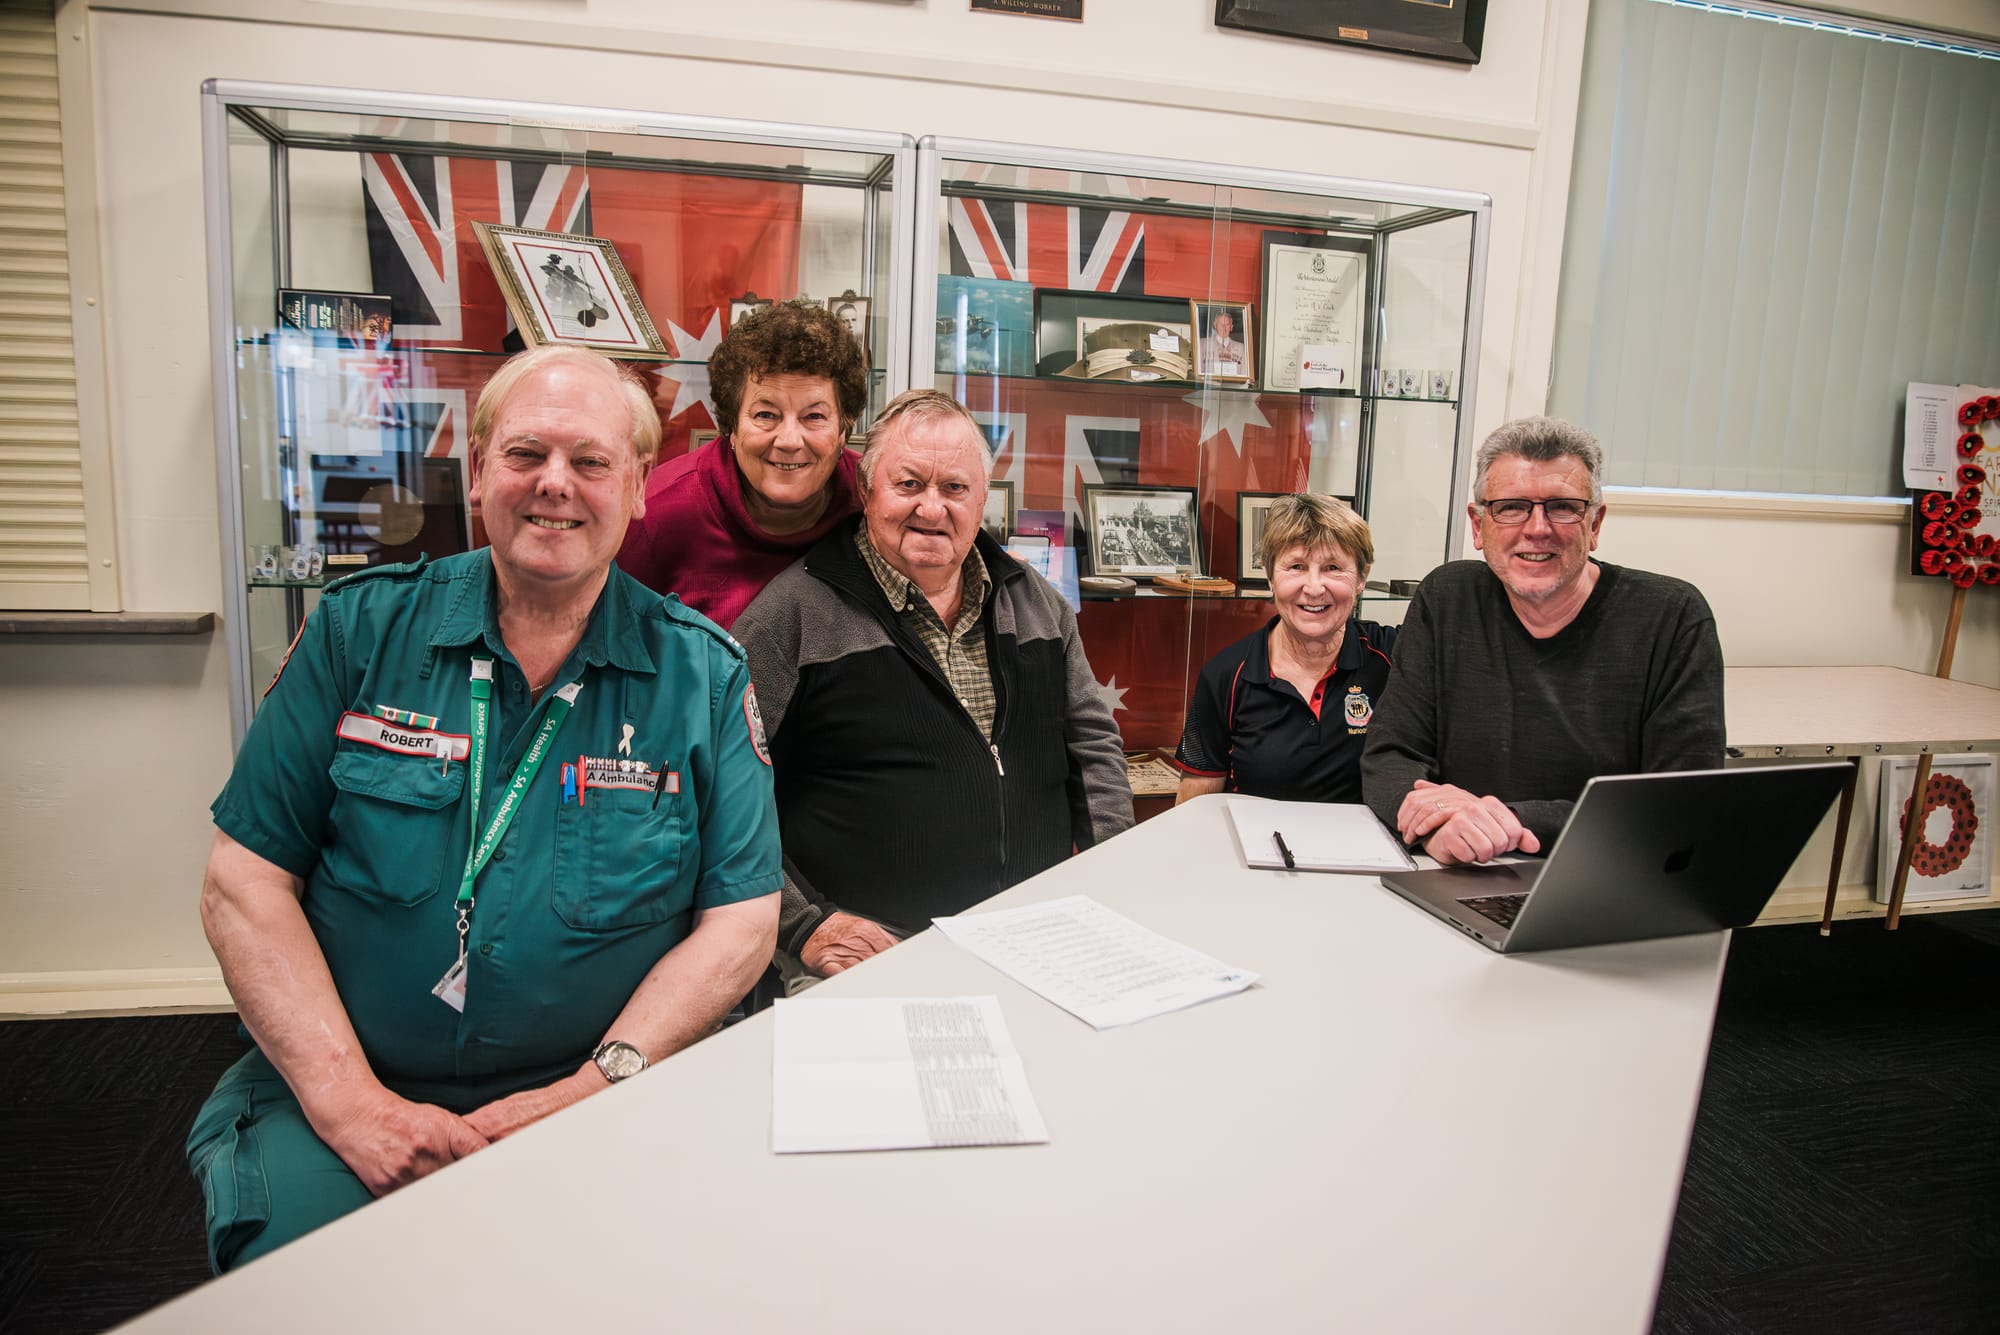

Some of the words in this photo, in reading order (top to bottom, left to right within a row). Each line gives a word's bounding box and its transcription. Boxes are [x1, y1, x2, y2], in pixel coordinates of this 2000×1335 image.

[1001, 0, 1029, 8] WILLING
[1033, 3, 1060, 11] WORKER
[476, 703, 486, 737] Service
[543, 718, 556, 732] SA
[379, 729, 434, 748] ROBERT
[527, 732, 549, 764] Health
[474, 740, 484, 795] Ambulance
[512, 775, 527, 789] SA
[598, 772, 657, 788] Ambulanc
[484, 790, 518, 843] Ambulance
